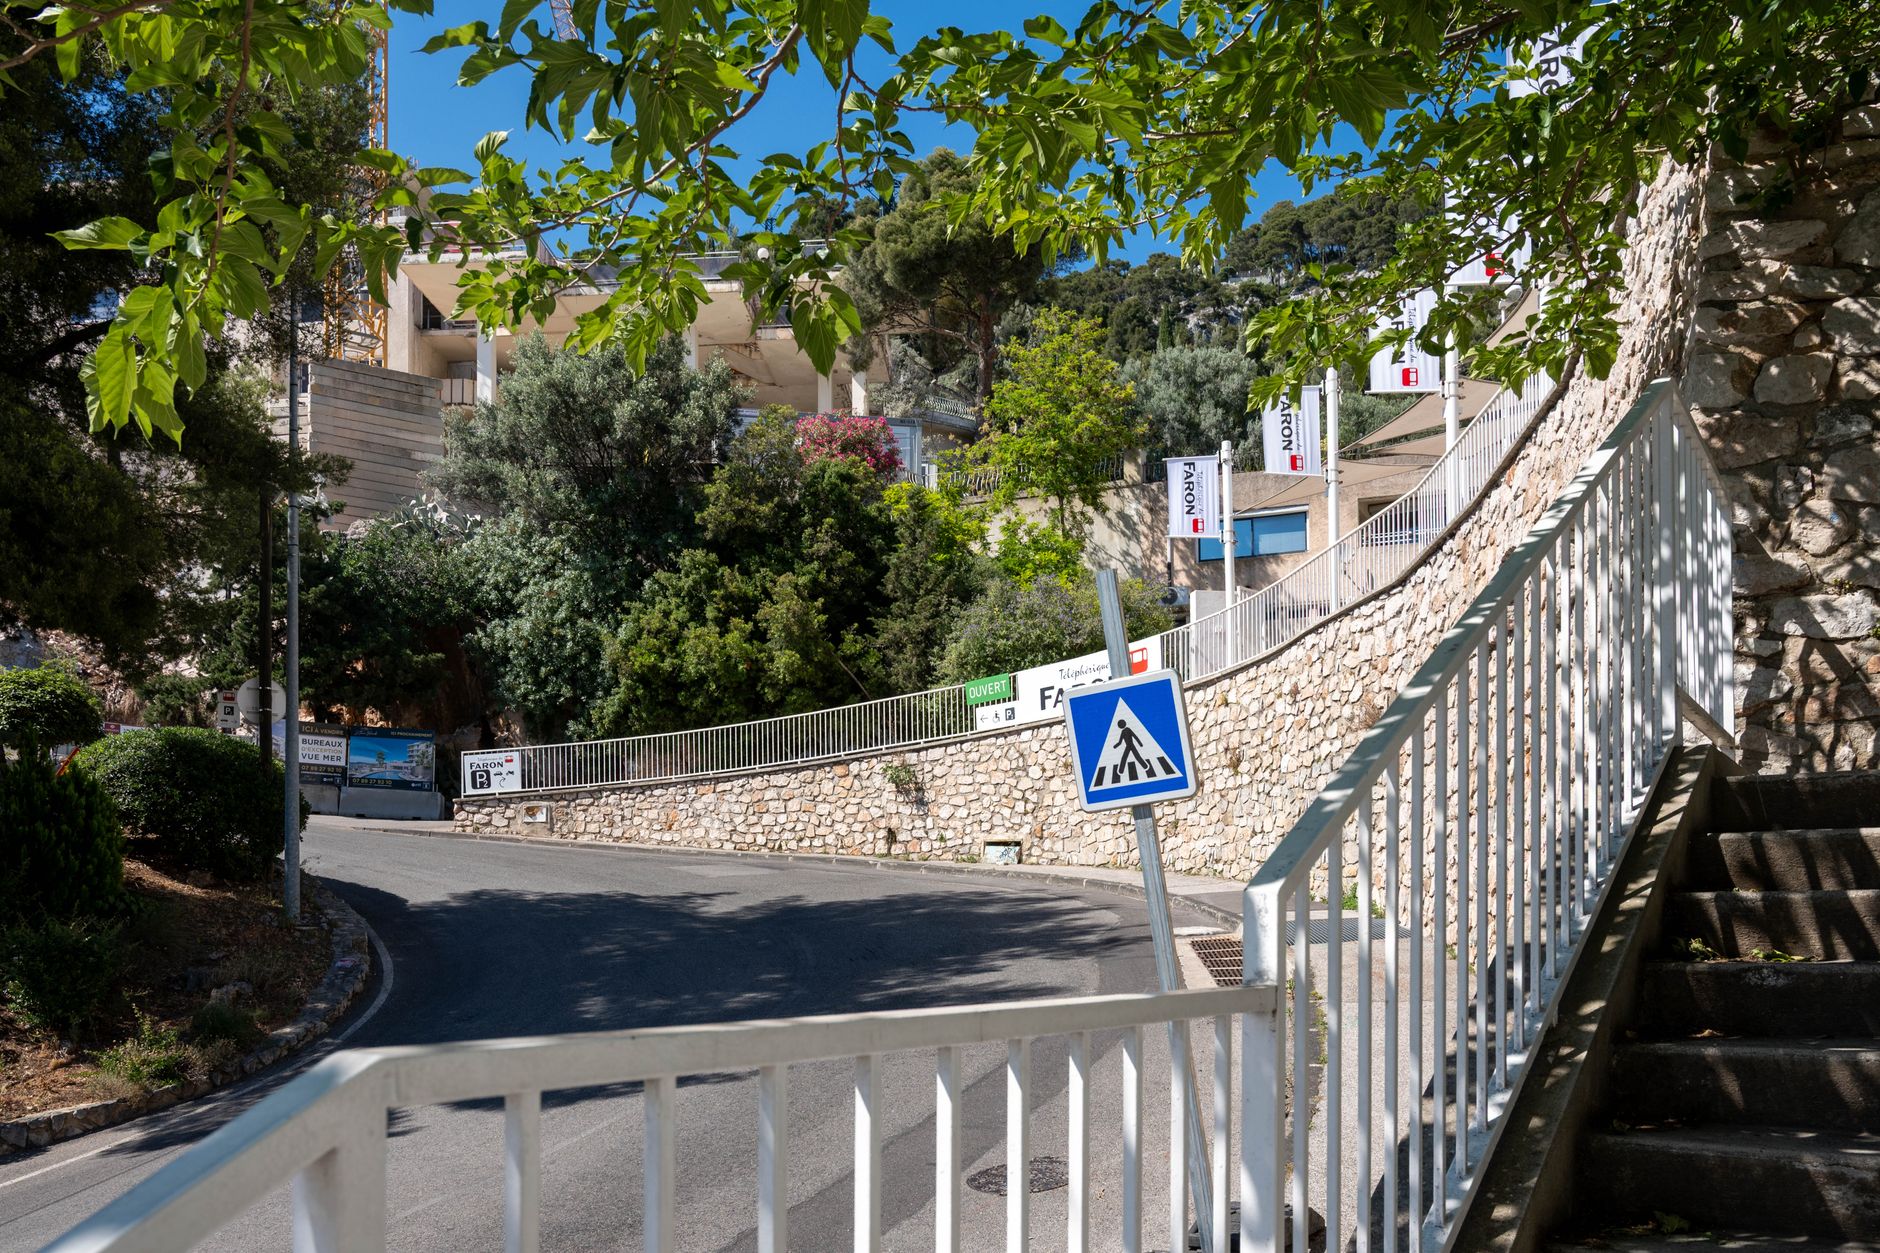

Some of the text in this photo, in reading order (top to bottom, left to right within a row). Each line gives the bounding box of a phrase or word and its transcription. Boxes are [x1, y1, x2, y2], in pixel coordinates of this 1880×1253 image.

[1183, 462, 1196, 515] FARON
[969, 680, 1007, 699] OUVERT
[302, 725, 313, 733] ICI
[302, 739, 342, 747] BUREAUX
[301, 746, 343, 755] D'EXCEPTION
[301, 753, 342, 762] VUE MER
